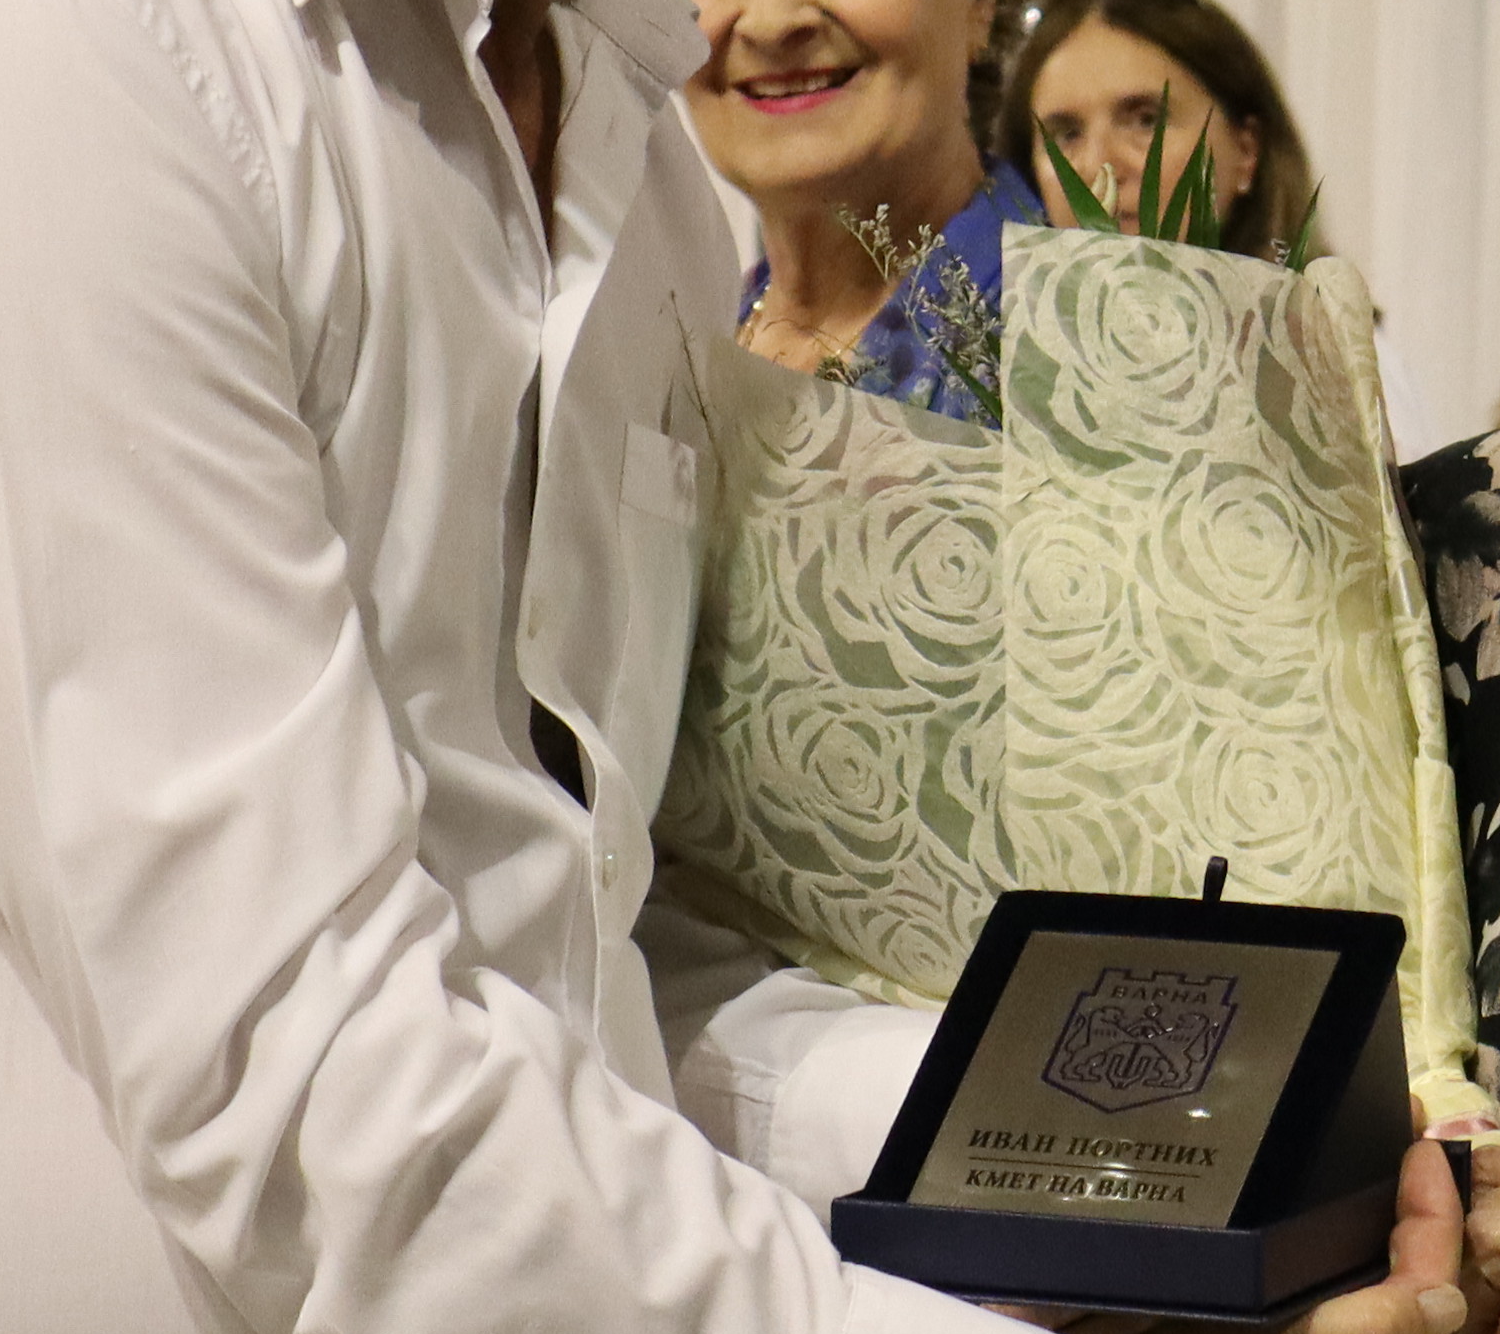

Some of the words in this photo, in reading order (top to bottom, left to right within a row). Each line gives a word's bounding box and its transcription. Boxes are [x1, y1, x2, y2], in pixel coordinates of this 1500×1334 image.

[1111, 985, 1208, 1005] ВАРНА
[967, 1128, 1058, 1154] ИВАН
[1065, 1136, 1219, 1167] ПОРТНИХ
[964, 1168, 1043, 1192] КМЕТ
[1048, 1174, 1087, 1196] НА
[1094, 1177, 1186, 1203] ВАРНА
